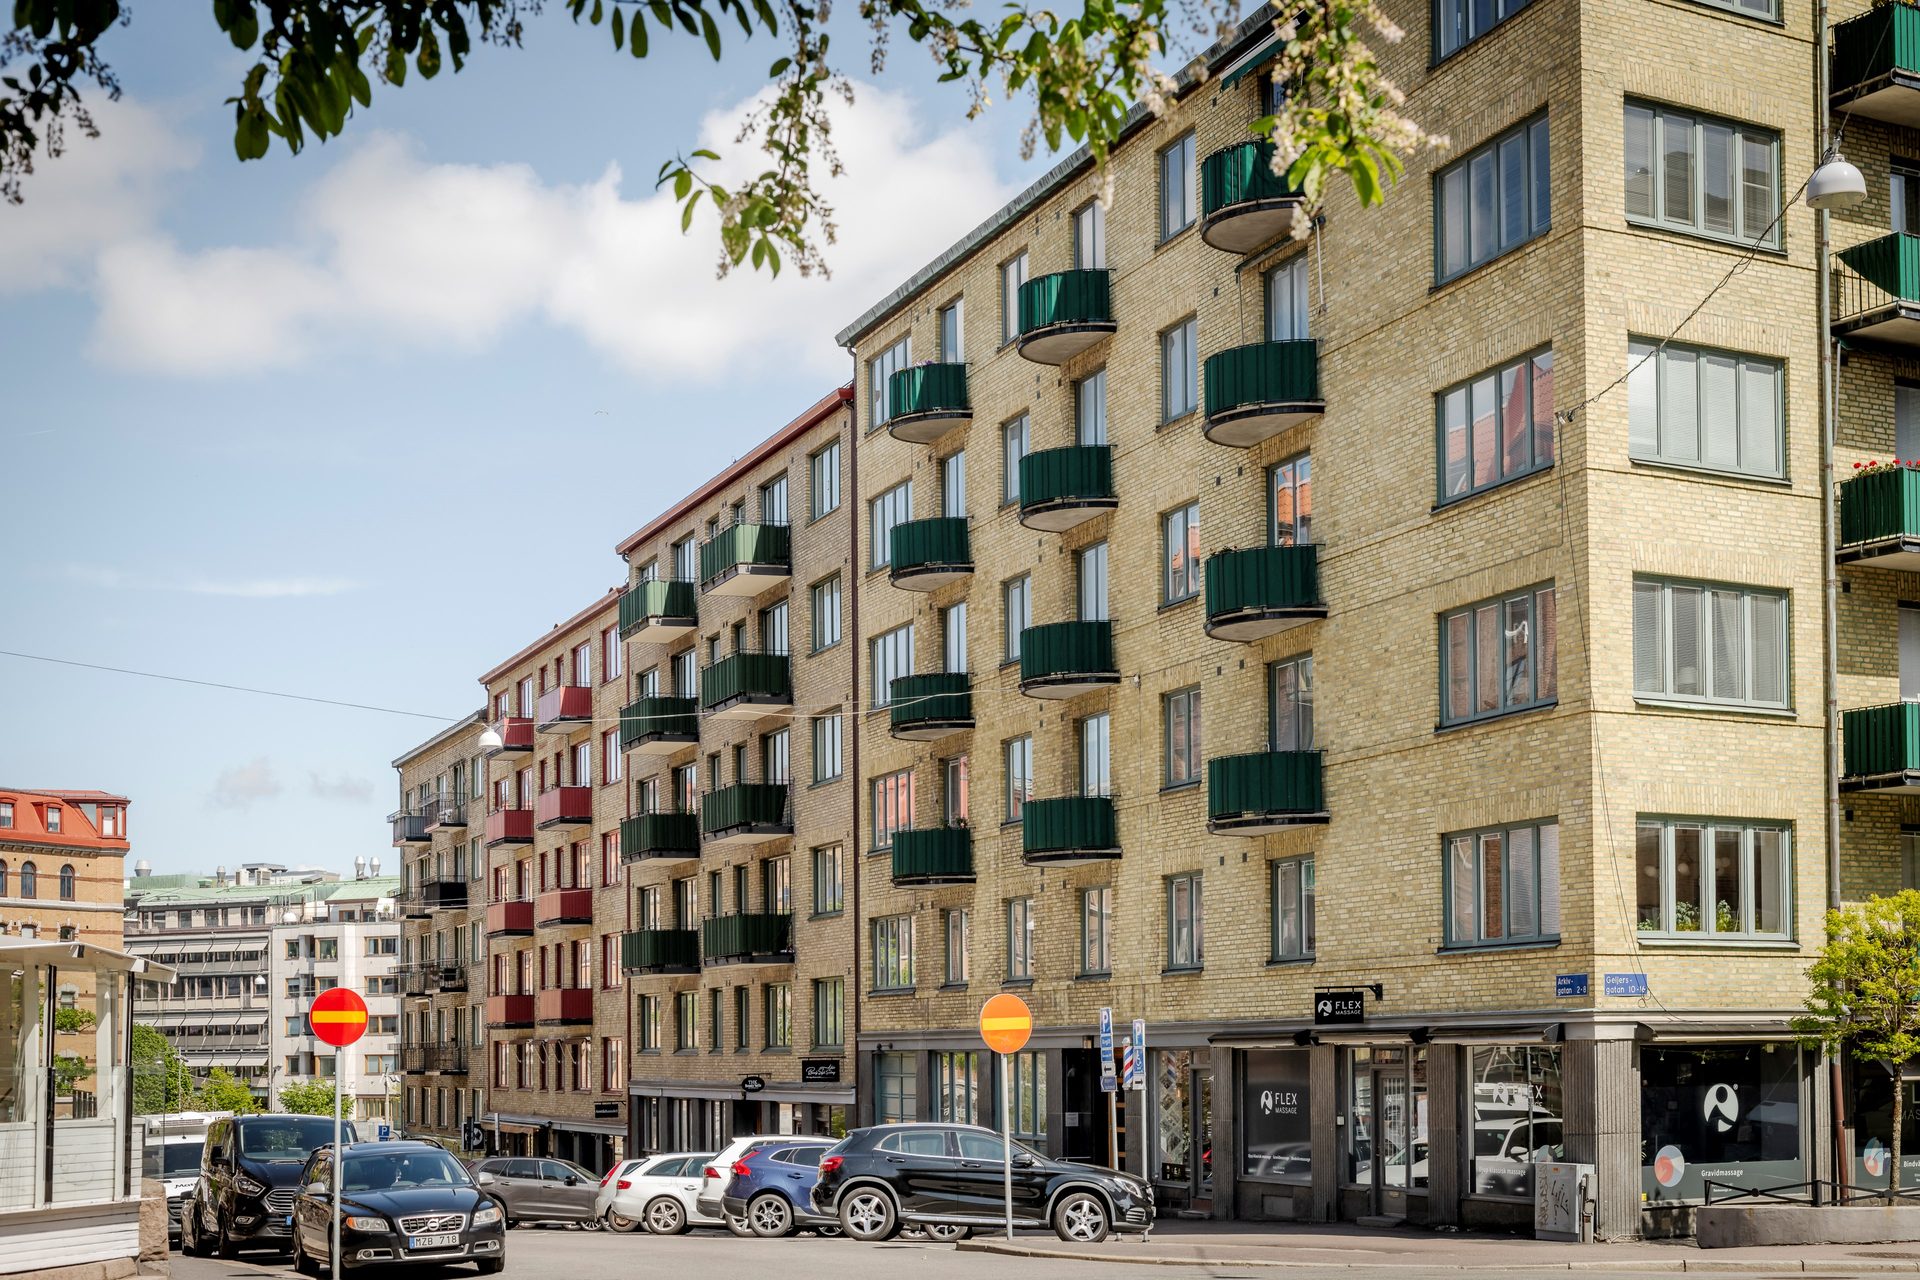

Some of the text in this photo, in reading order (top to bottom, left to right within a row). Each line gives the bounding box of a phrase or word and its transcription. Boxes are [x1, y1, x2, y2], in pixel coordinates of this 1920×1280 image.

[1606, 976, 1632, 985] Geijers-
[1557, 987, 1572, 996] gatan
[1606, 986, 1624, 994] gatan
[1335, 1000, 1361, 1010] FLEX
[1102, 1010, 1109, 1033] P
[1275, 1092, 1297, 1105] FLEX
[381, 1126, 388, 1136] P
[1506, 1168, 1526, 1177] massage
[1701, 1169, 1743, 1177] Gravidmassage
[415, 1235, 457, 1247] MZB 718
